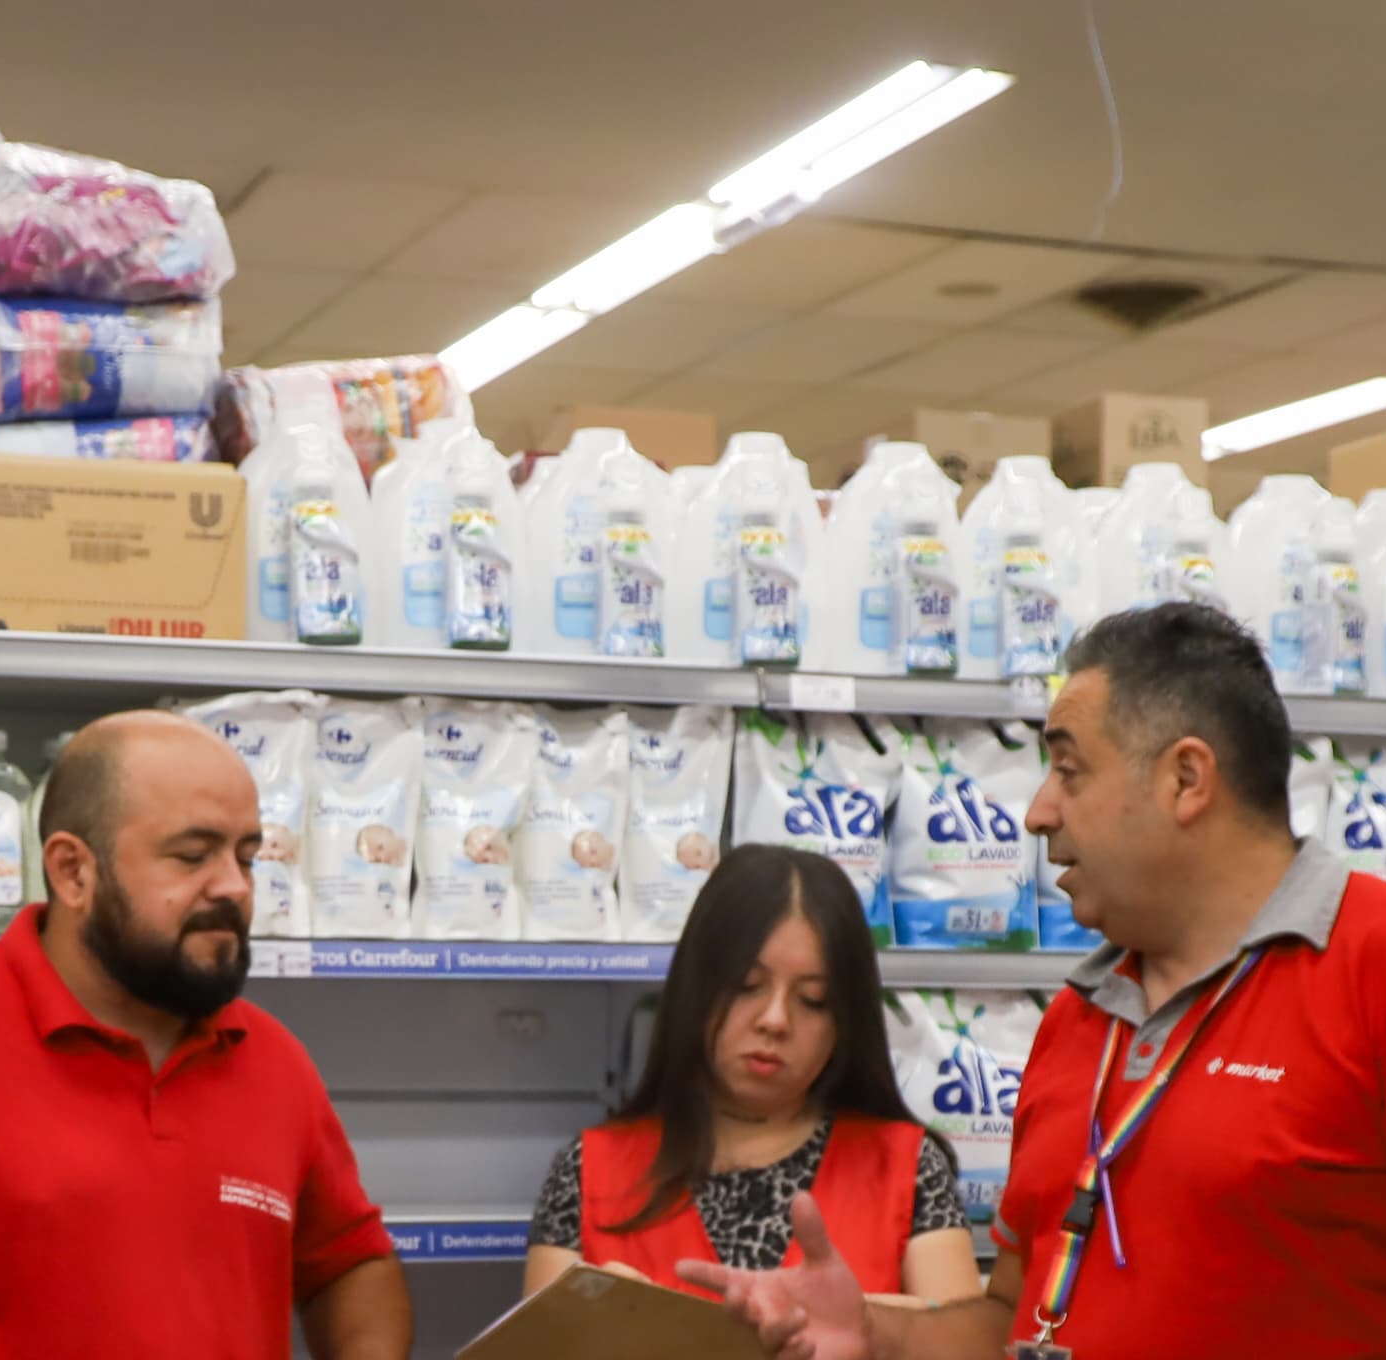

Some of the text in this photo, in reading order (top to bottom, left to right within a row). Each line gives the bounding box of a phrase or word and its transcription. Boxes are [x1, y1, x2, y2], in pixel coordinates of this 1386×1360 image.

[784, 783, 884, 839] ala
[927, 777, 1019, 842] ala
[348, 947, 439, 969] Carrefour
[458, 952, 545, 970] Defendiendo
[547, 954, 586, 973] precio
[600, 952, 649, 969] calidad
[972, 1118, 1013, 1134] LAVA
